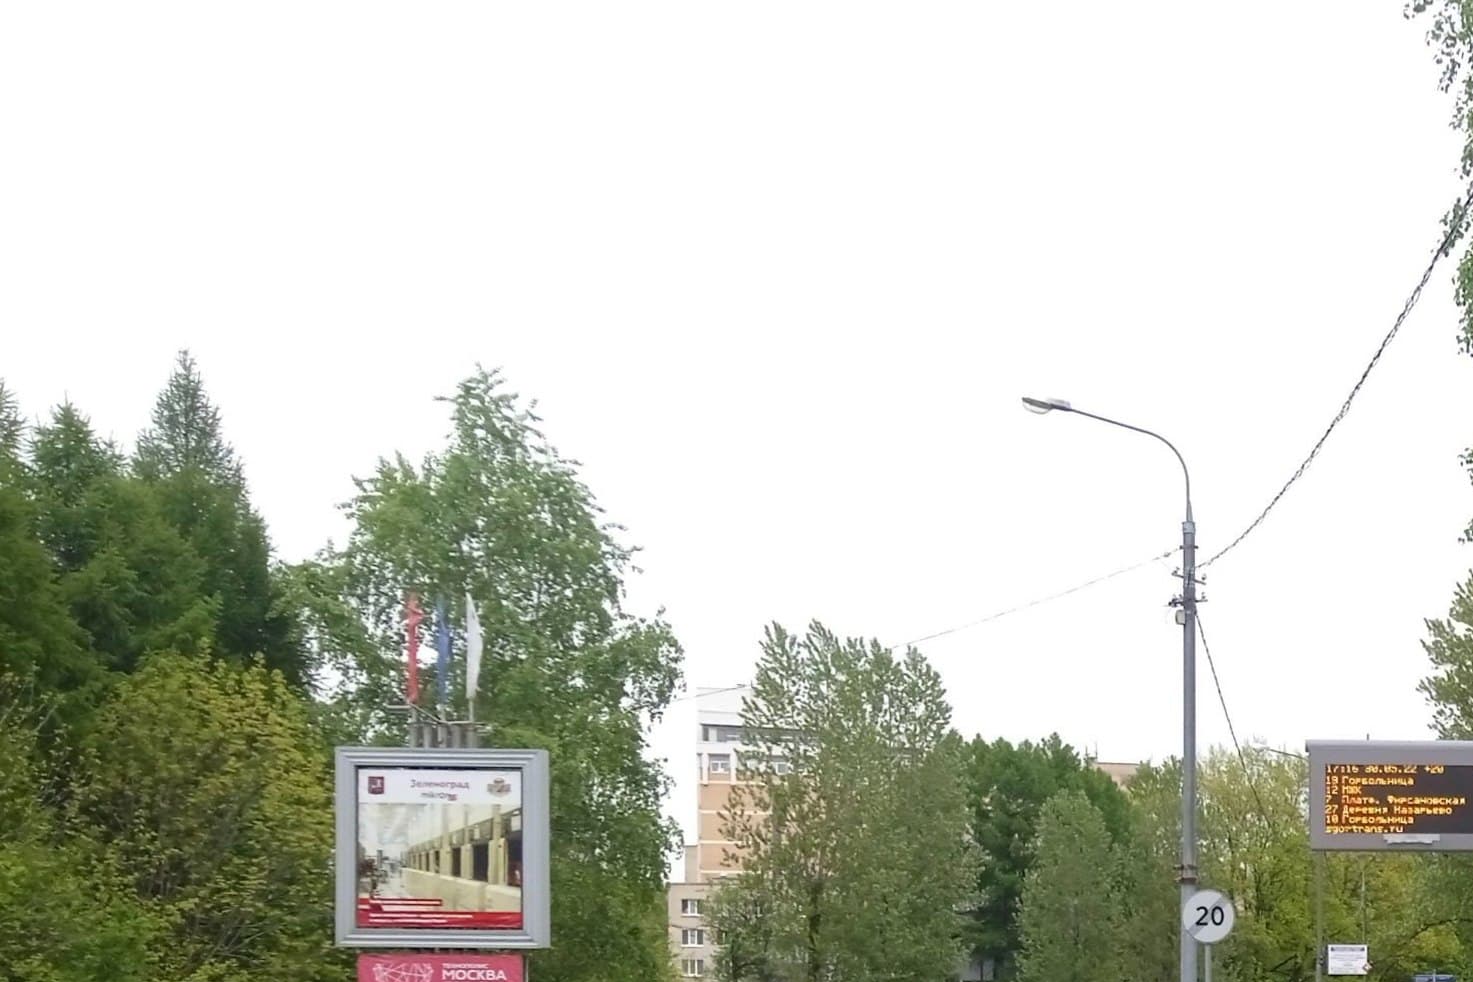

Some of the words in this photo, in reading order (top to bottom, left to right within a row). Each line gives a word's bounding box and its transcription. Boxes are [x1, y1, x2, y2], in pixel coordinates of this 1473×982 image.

[1325, 786, 1338, 795] 12
[1325, 805, 1338, 815] 27
[1195, 906, 1225, 926] 20
[442, 969, 507, 981] МОСКВА
